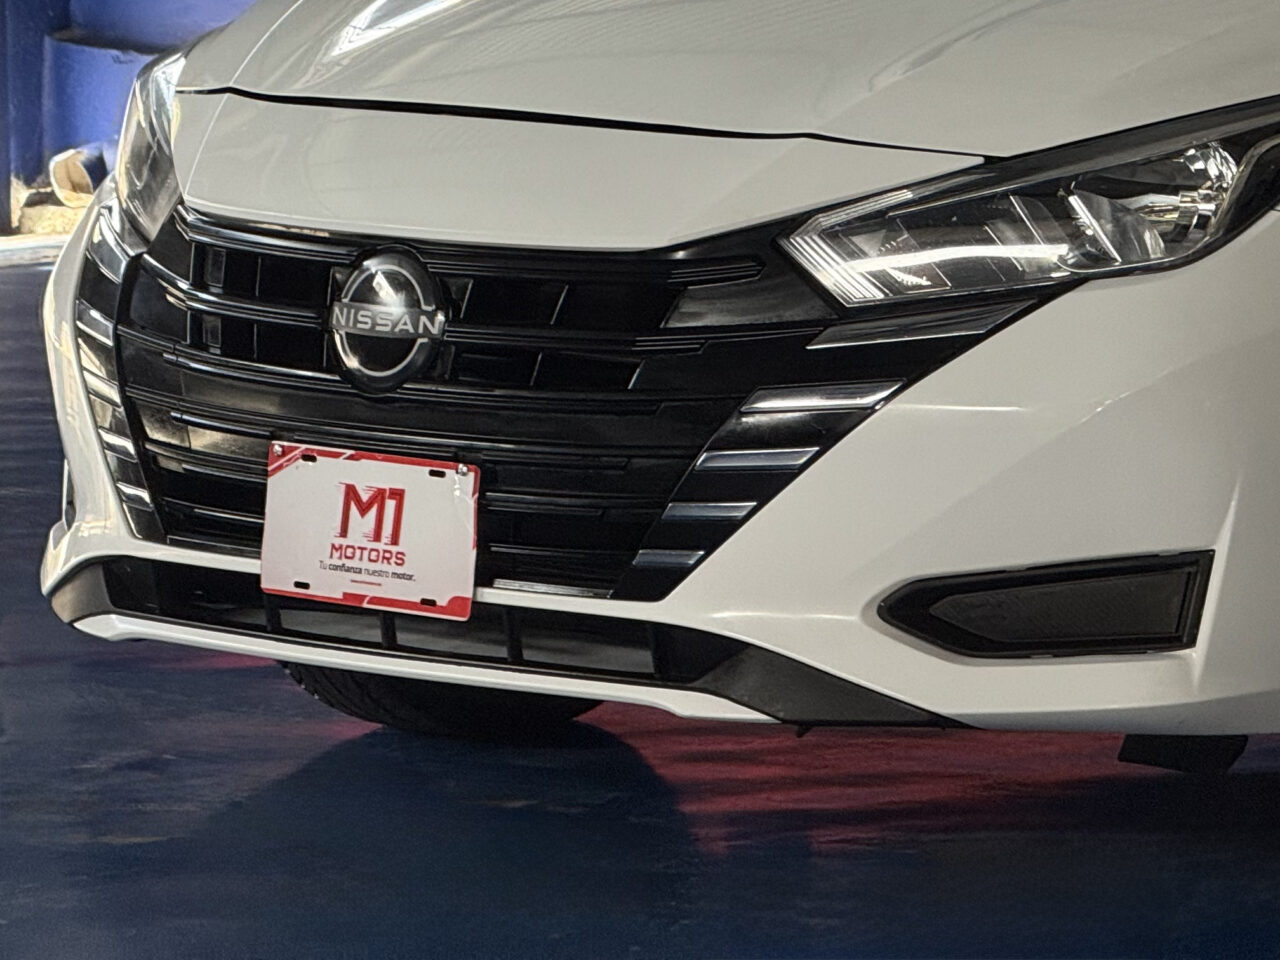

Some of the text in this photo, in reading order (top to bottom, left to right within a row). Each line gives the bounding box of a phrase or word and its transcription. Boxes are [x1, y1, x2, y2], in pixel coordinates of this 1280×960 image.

[332, 306, 441, 335] NISSAN
[334, 481, 406, 546] M1
[329, 542, 406, 567] MOTORS
[319, 560, 328, 570] Tu
[328, 563, 363, 575] confianza
[363, 567, 390, 579] nuestro
